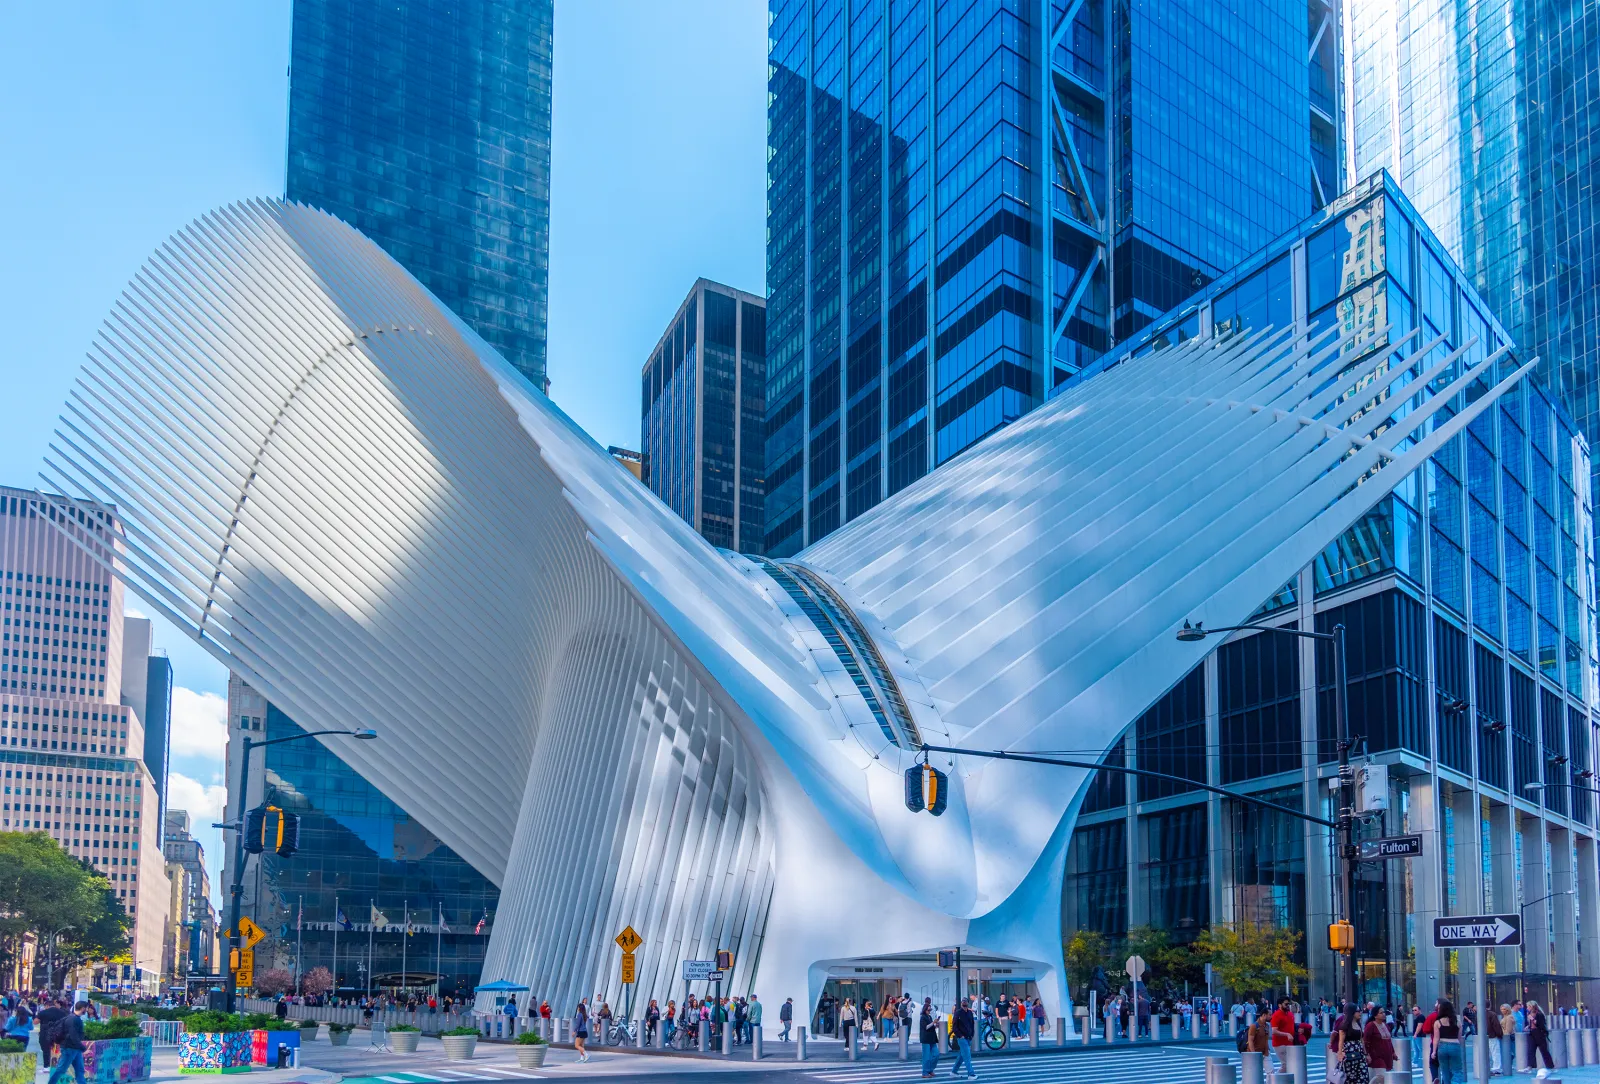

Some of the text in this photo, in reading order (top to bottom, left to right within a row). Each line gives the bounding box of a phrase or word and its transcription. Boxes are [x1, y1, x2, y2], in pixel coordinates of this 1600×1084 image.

[1381, 842, 1409, 853] Fulton
[306, 922, 334, 931] THE
[1442, 925, 1499, 938] ONE WAY
